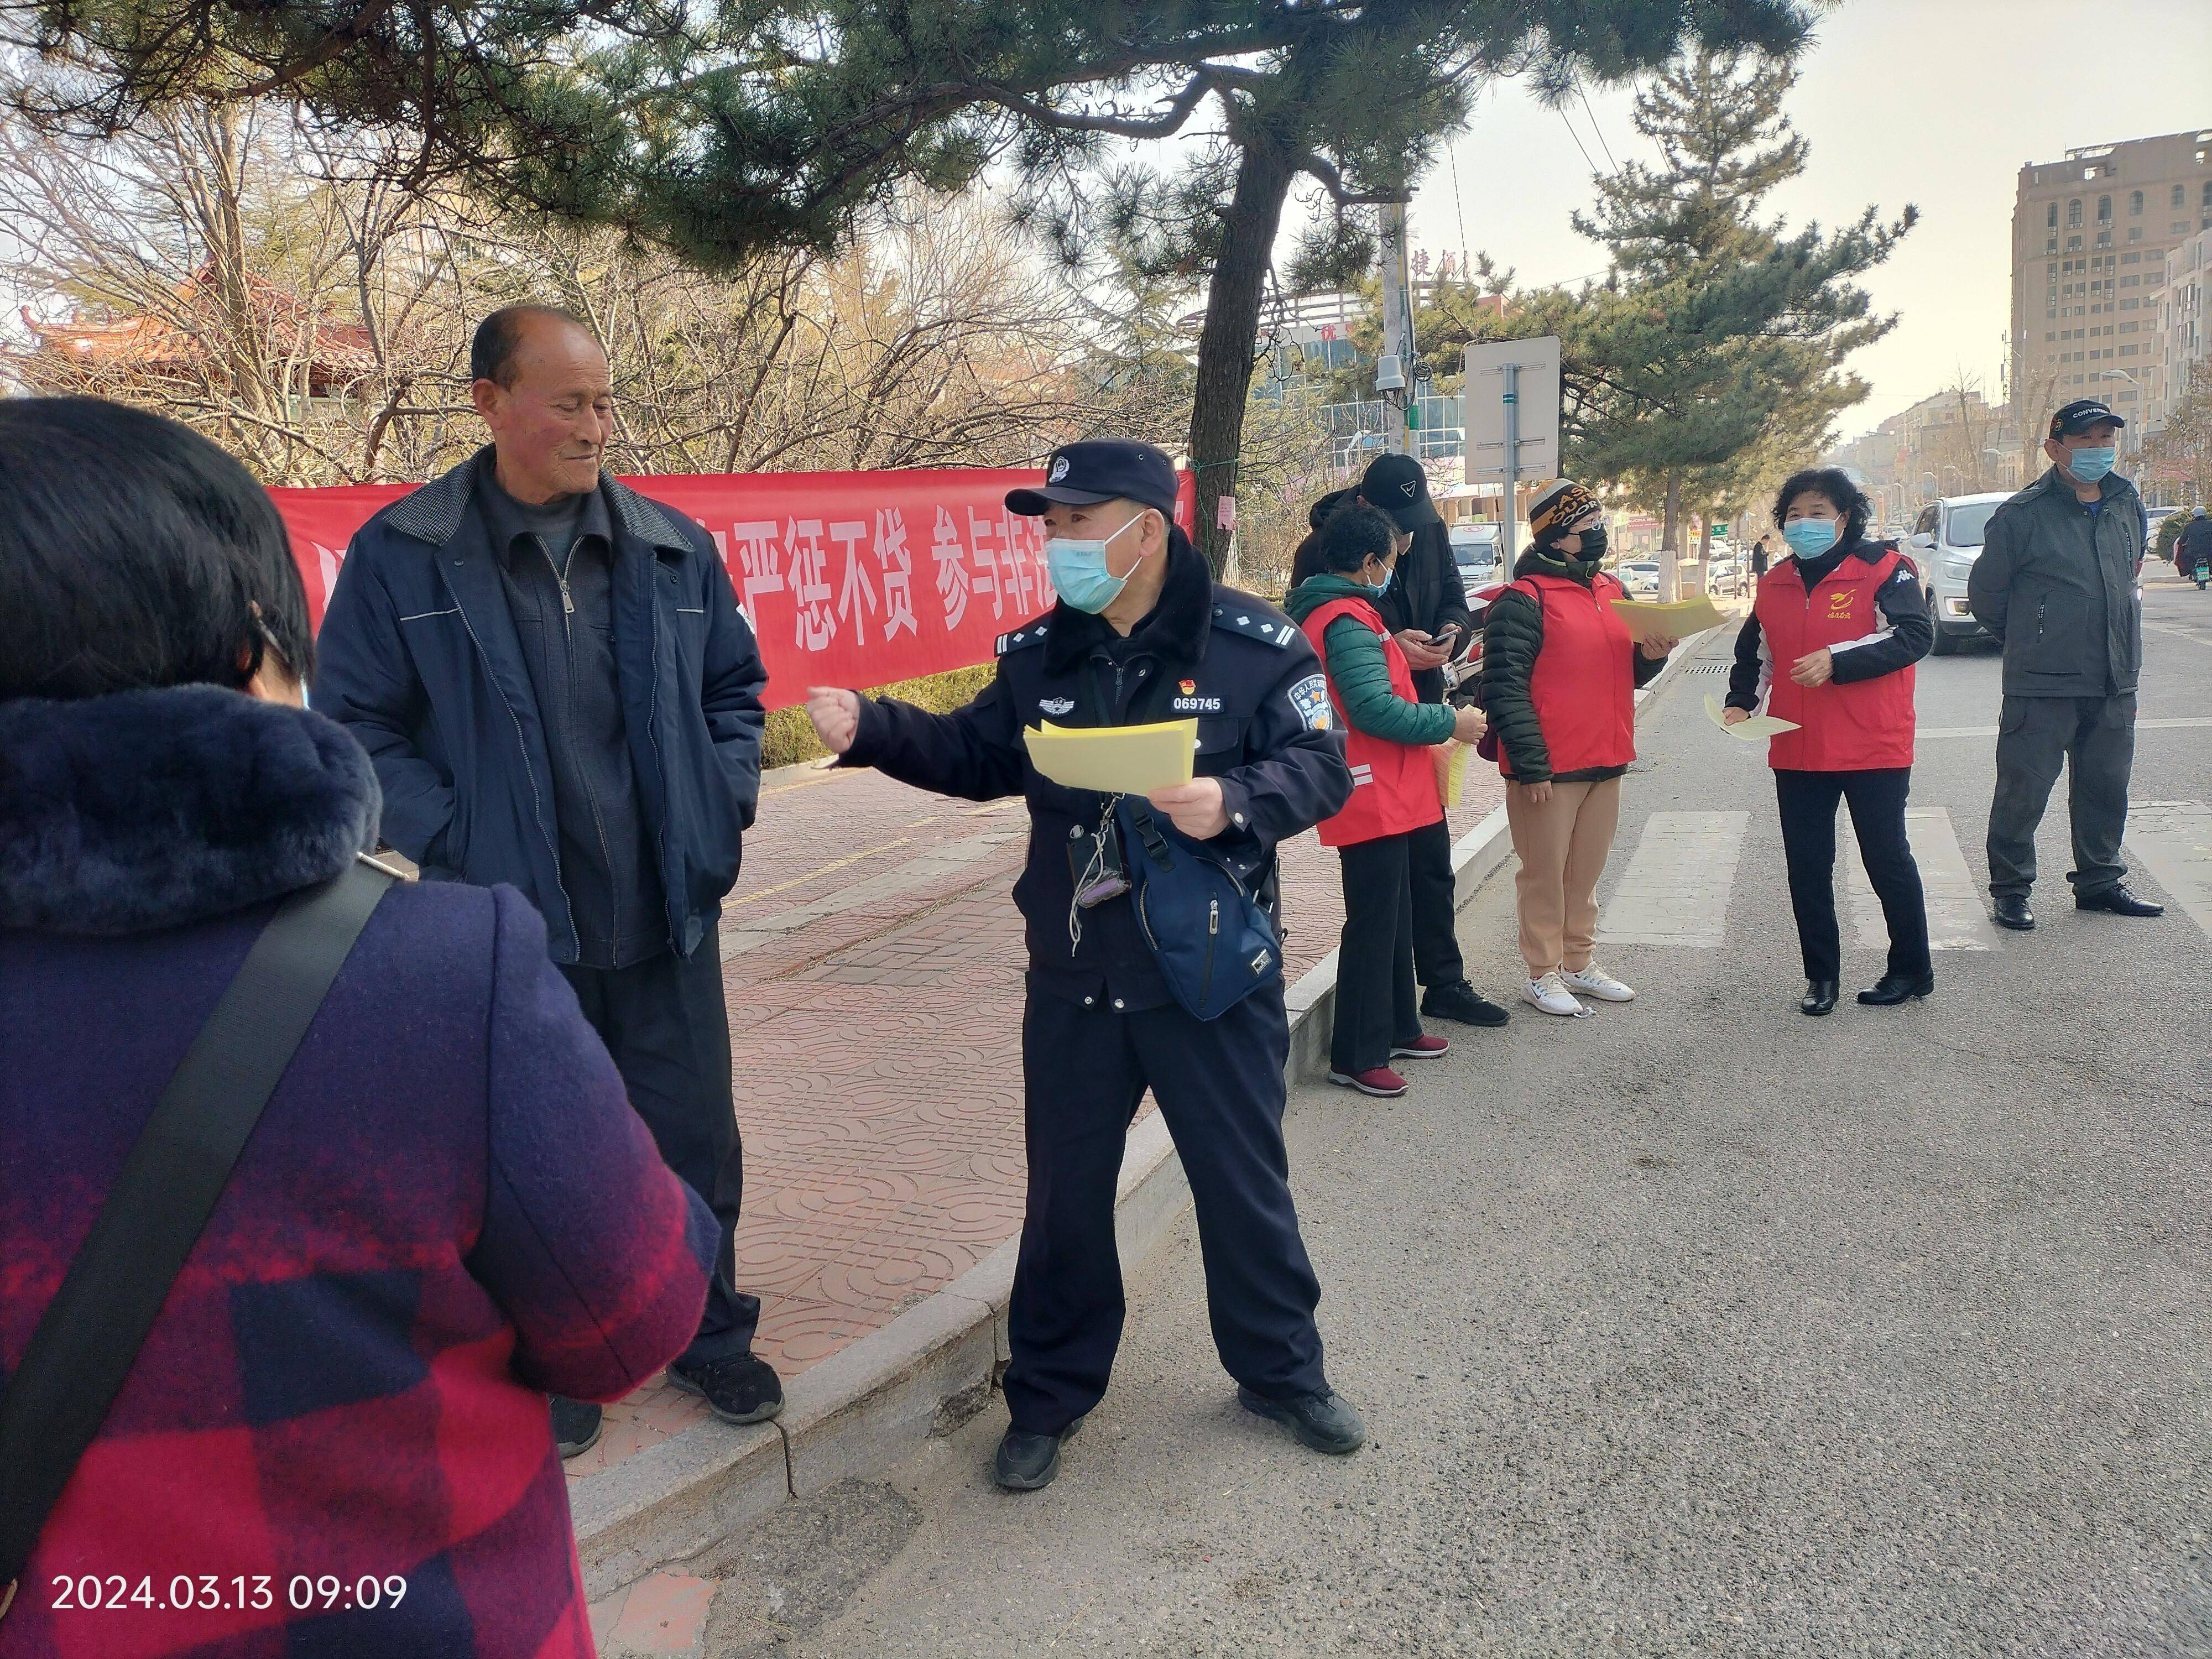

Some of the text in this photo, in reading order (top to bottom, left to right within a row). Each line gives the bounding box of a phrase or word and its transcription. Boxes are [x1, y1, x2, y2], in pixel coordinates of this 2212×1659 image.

[696, 506, 918, 651] 严惩不贷
[1173, 697, 1220, 709] 069745
